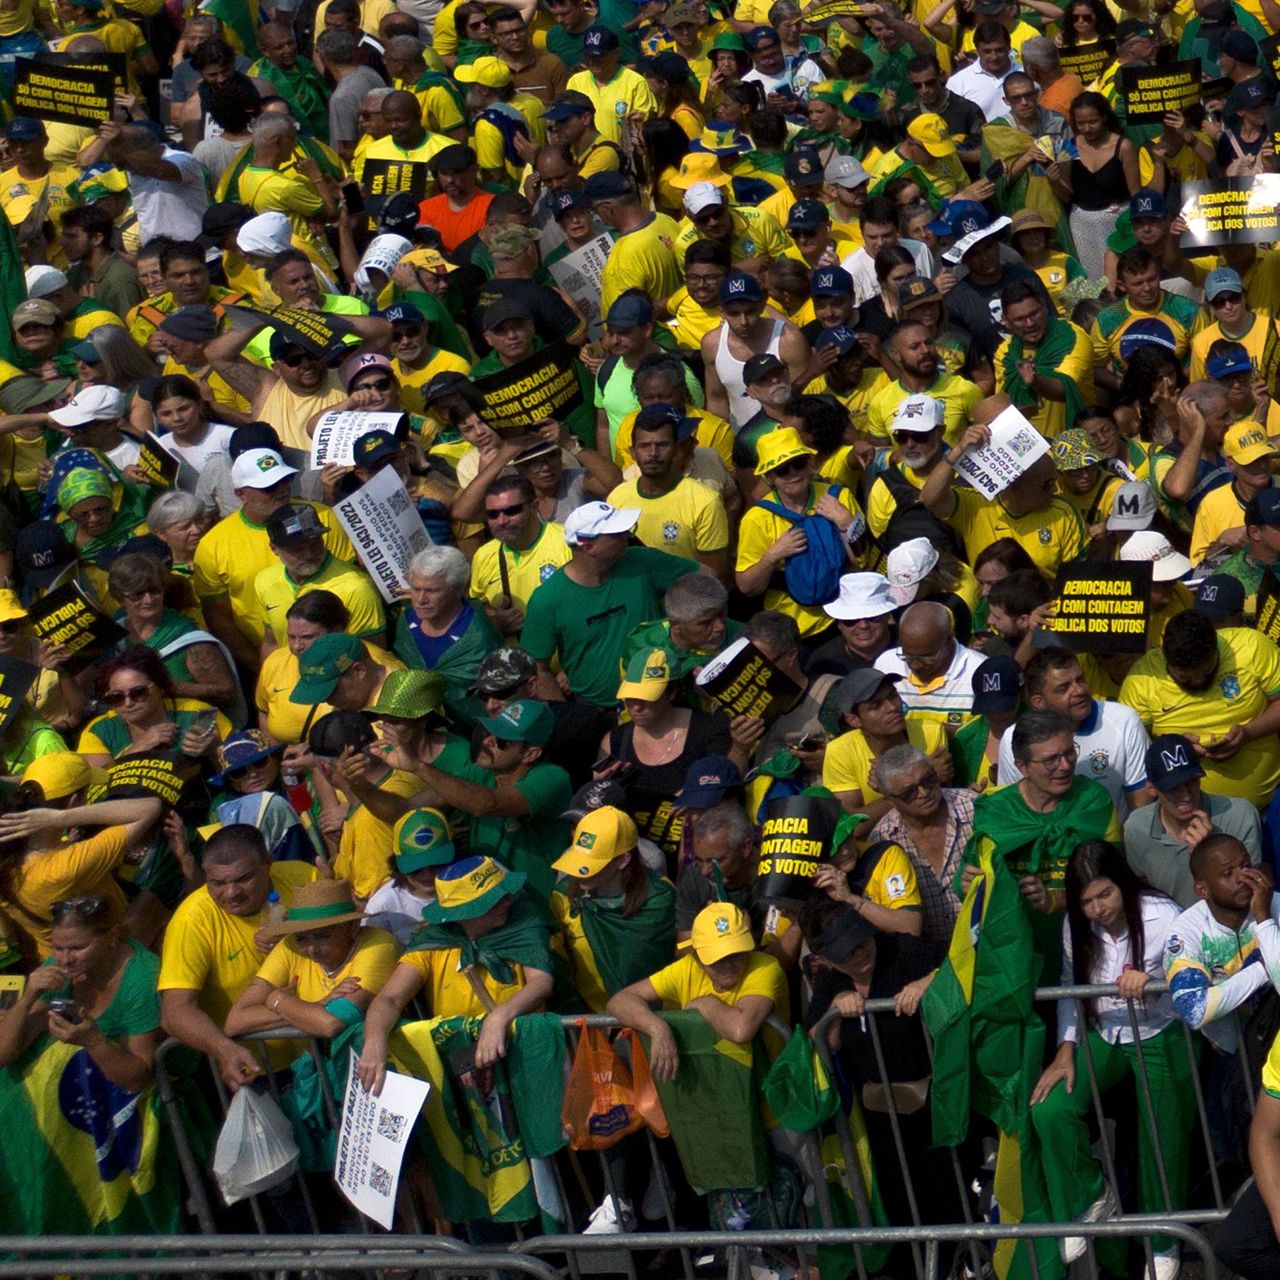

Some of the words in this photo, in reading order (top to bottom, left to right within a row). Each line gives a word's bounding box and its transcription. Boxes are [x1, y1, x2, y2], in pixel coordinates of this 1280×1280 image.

[30, 73, 95, 94] DEMOCRACIA
[17, 83, 30, 95] SÓ
[31, 86, 53, 100] COM
[54, 89, 108, 108] CONTAGEM
[17, 93, 55, 112] PÚBLICA
[58, 102, 74, 114] DOS
[76, 104, 110, 120] VOTOS!
[1119, 496, 1139, 515] M
[1063, 581, 1132, 596] DEMOCRACIA
[1062, 600, 1086, 614] COM
[1088, 600, 1144, 614] CONTAGEM
[1088, 619, 1109, 633] DOS
[1111, 619, 1145, 633] VOTOS!
[1160, 744, 1189, 772] M
